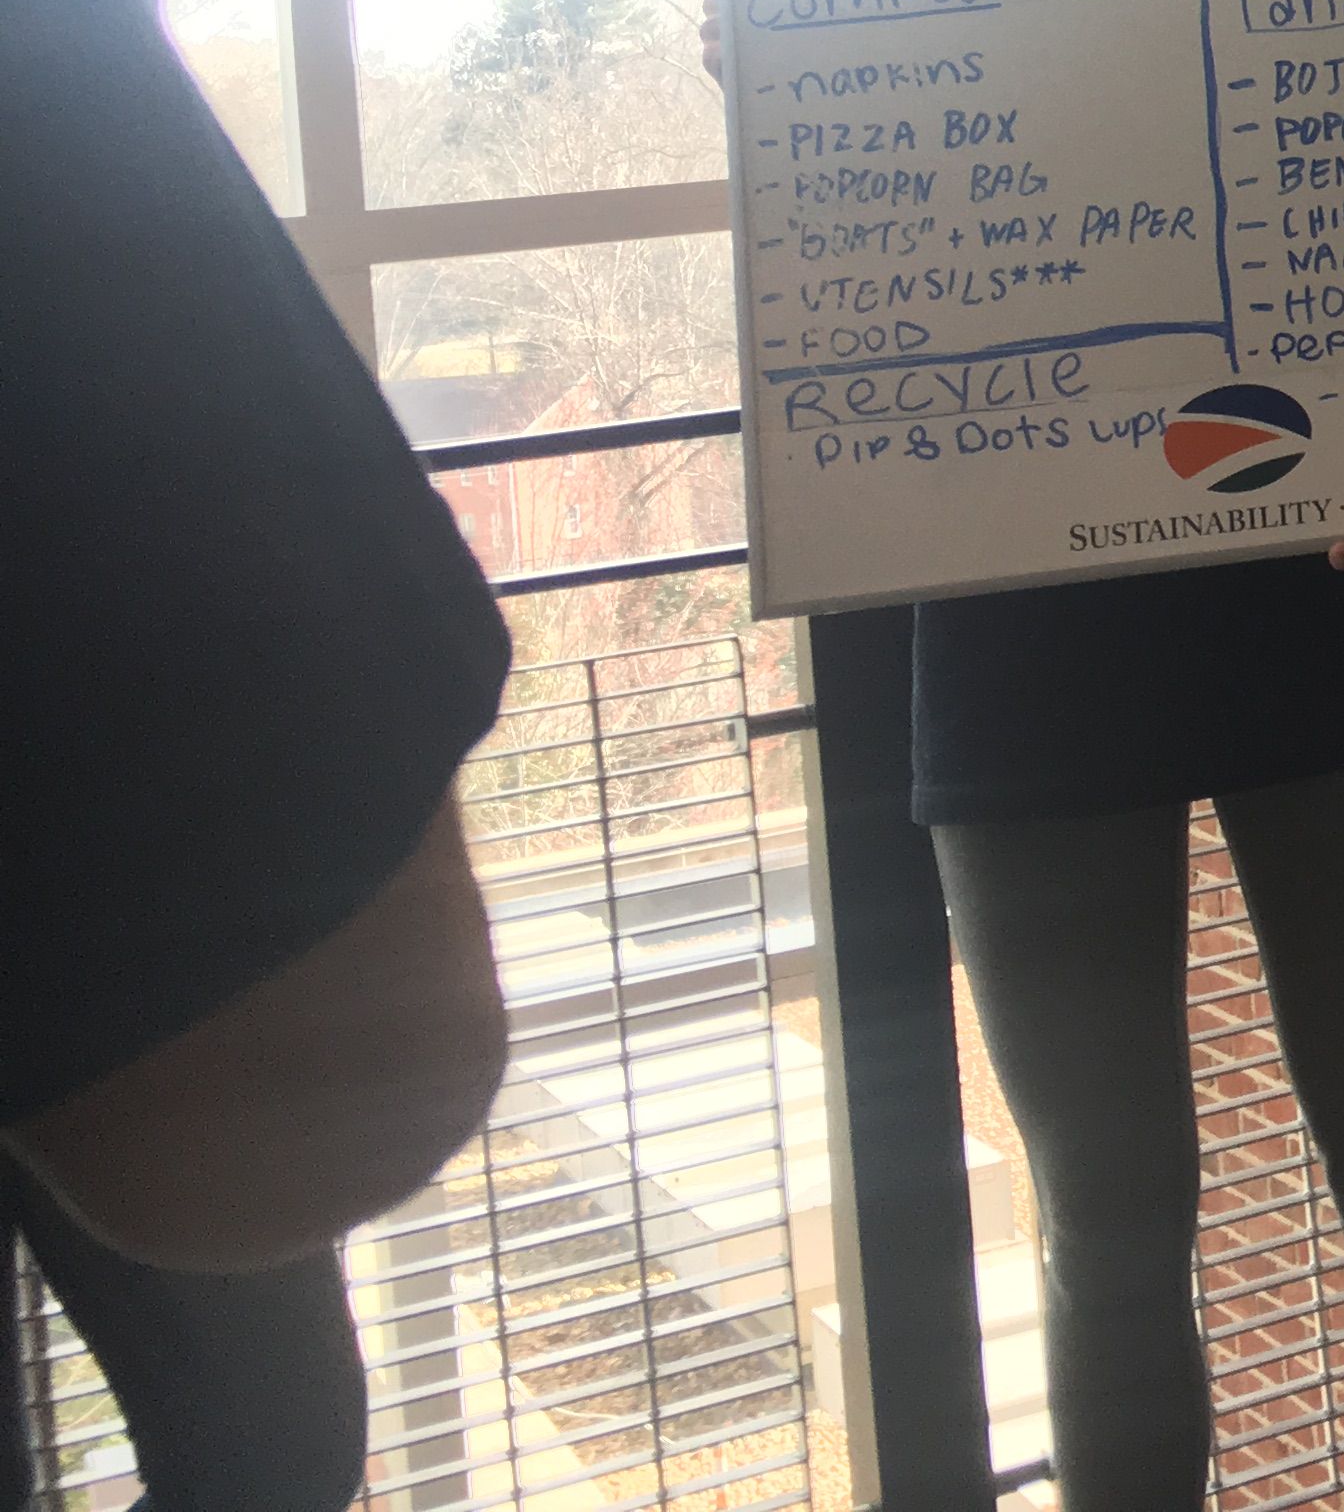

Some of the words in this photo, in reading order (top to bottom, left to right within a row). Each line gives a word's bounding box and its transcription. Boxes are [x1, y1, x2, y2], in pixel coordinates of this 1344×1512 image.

[788, 120, 917, 161] PIZZA
[943, 108, 1019, 151] BOX
[970, 160, 1049, 203] BAG
[980, 213, 1058, 249] WAX
[1080, 201, 1197, 248] PAPER
[800, 320, 932, 358] FOOD
[1069, 497, 1335, 552] SUSTAINABILITY
